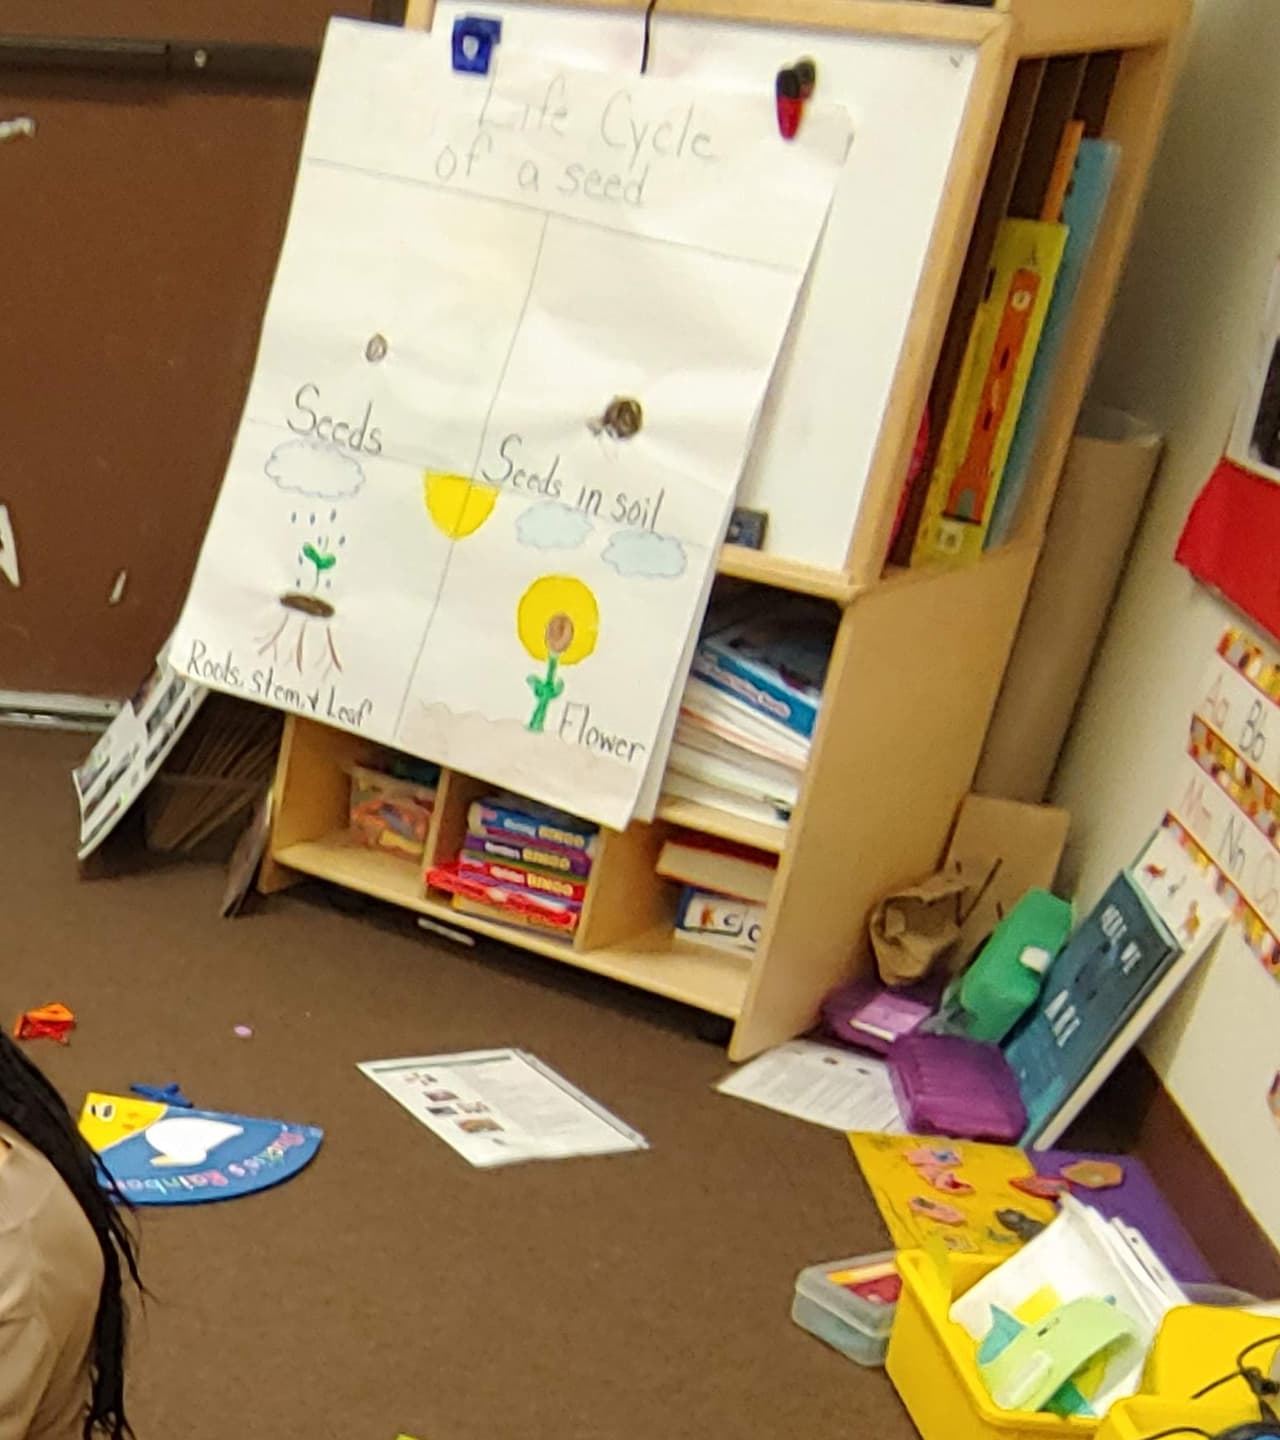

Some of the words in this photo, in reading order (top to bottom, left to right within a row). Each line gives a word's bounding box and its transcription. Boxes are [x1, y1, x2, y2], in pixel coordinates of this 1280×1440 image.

[477, 60, 570, 138] Life
[600, 88, 718, 172] Cycle
[435, 129, 493, 182] of
[517, 160, 539, 192] a
[556, 163, 650, 207] seed
[287, 383, 383, 456] Seeds
[481, 433, 562, 498] Seeds
[578, 484, 602, 517] in
[610, 488, 665, 532] soil
[327, 689, 374, 728] Leaf
[556, 701, 647, 763] Flower
